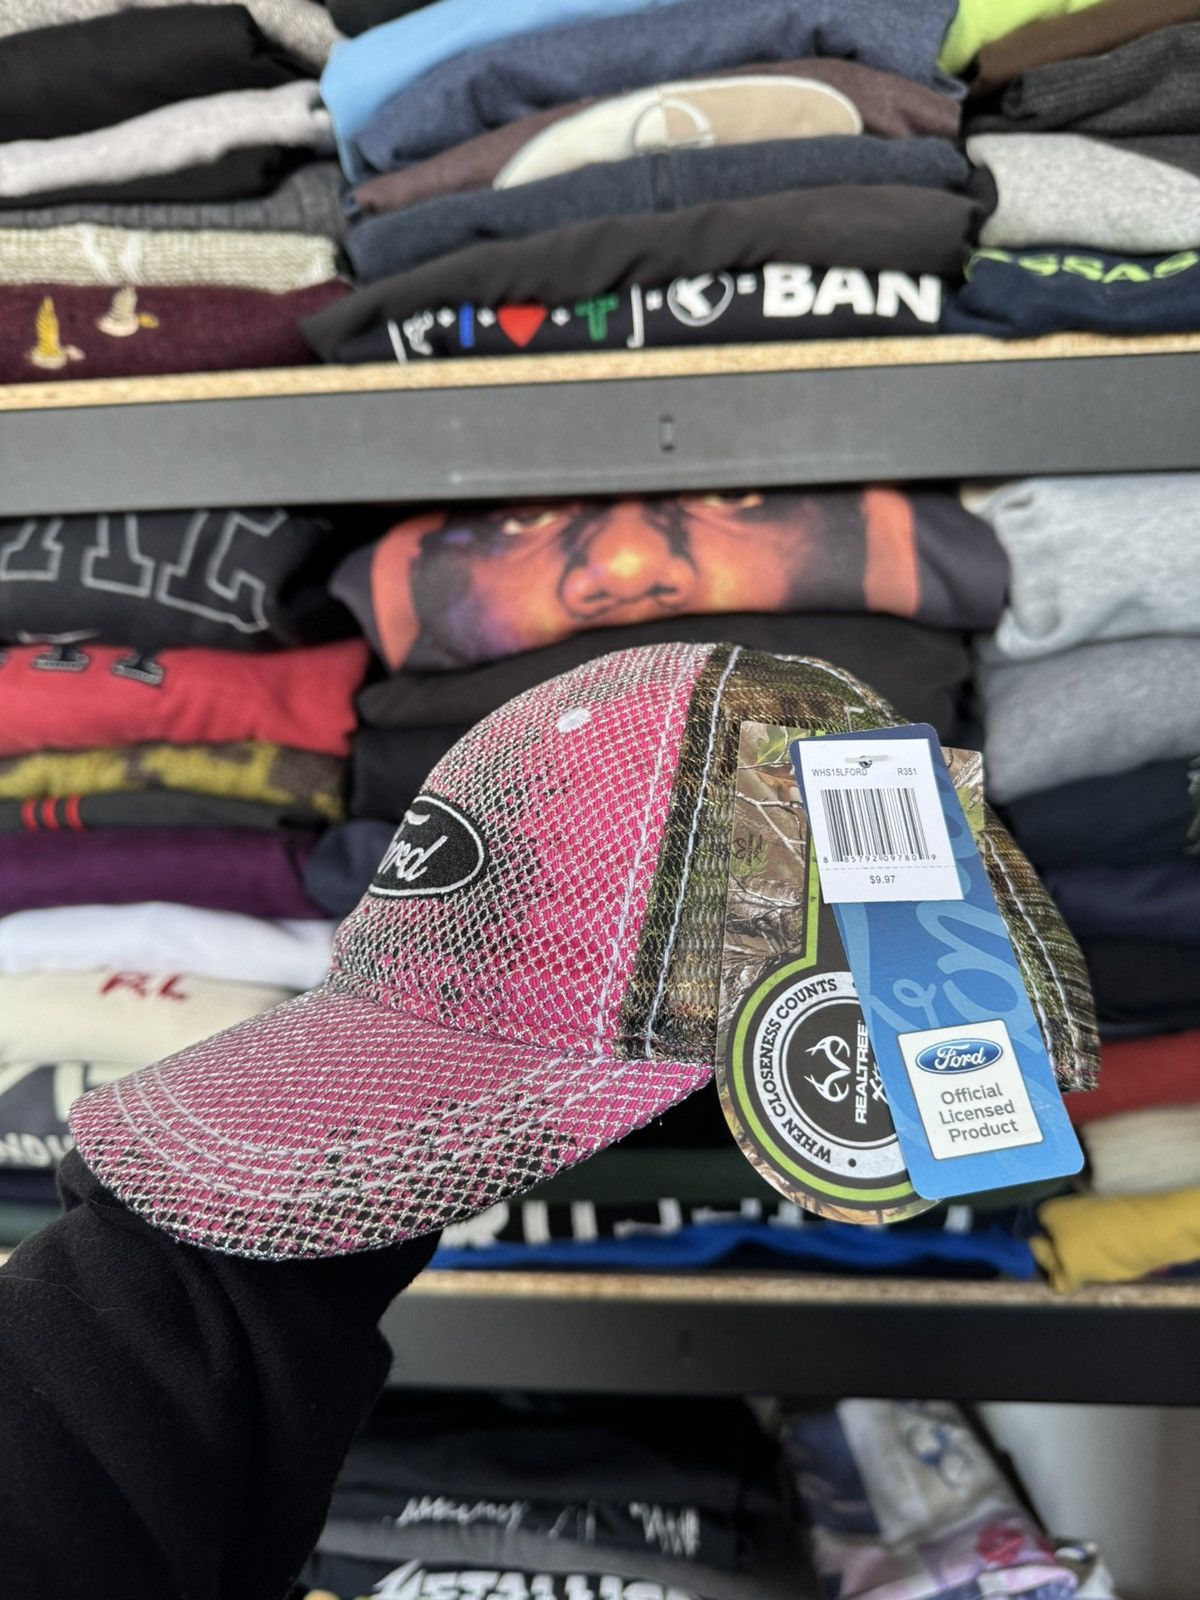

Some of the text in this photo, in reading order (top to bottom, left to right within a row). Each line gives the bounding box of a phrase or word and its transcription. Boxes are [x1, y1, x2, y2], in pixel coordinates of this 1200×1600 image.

[763, 263, 942, 324] BAN
[811, 768, 918, 777] WHS15LFORD R351
[869, 875, 896, 885] $9.97
[934, 1043, 986, 1070] Ford
[760, 978, 838, 1164] WHEN CLOSENESS COUNTS
[855, 1024, 868, 1125] REALTREE
[940, 1083, 1003, 1105] Official
[939, 1100, 1016, 1125] Licensed
[948, 1119, 1019, 1143] Product
